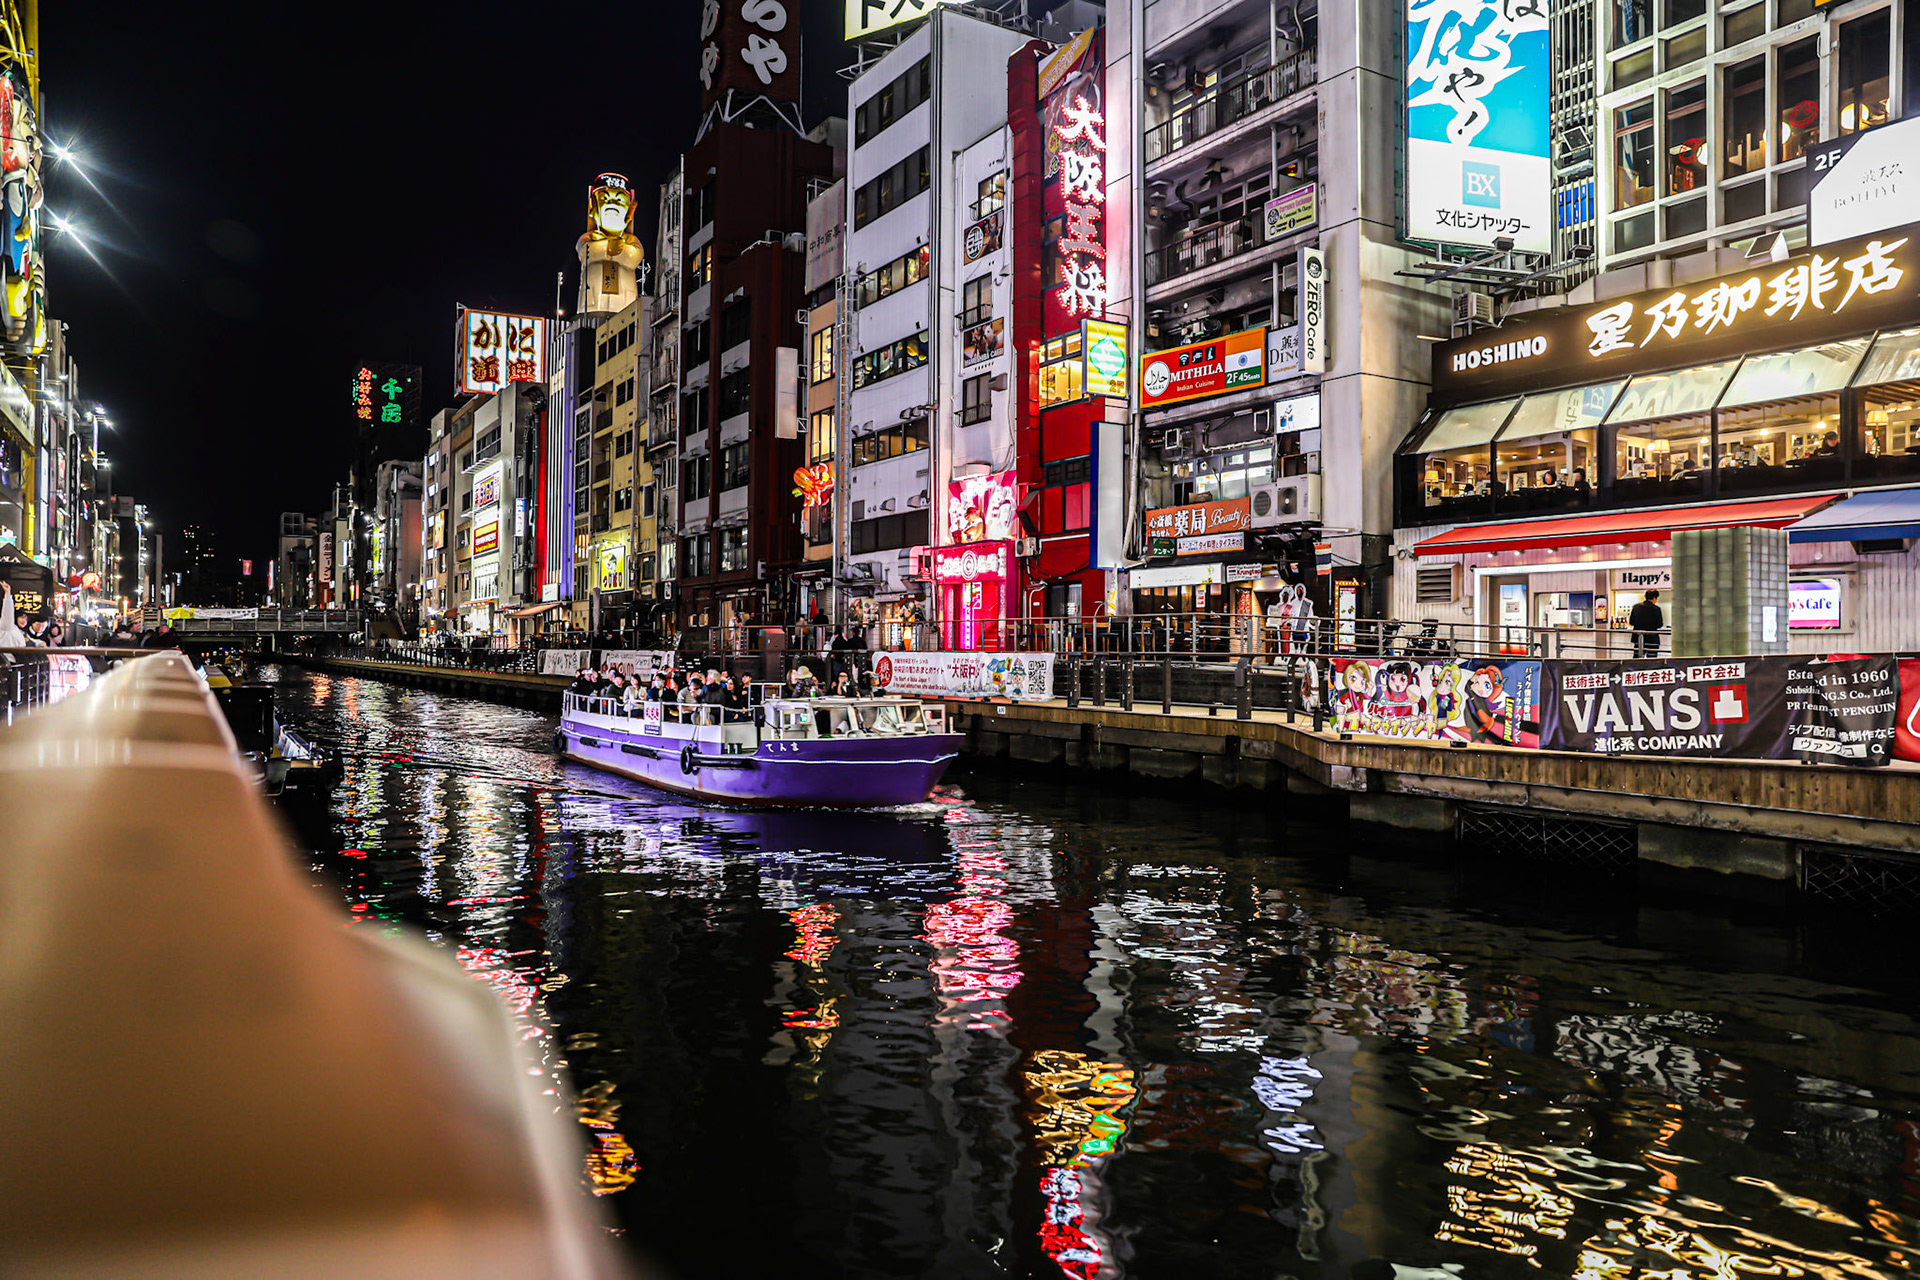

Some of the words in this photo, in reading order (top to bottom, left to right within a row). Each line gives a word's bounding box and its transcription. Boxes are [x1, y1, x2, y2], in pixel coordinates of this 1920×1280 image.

[1814, 148, 1842, 171] 2F
[1467, 172, 1496, 198] BX
[1054, 93, 1106, 316] 大阪王将
[1307, 280, 1319, 327] ZERO
[1586, 237, 1909, 357] 星乃珈琲店
[471, 319, 536, 355] かに
[1452, 335, 1548, 372] HOSHINO
[1170, 362, 1224, 383] MITHILA
[1226, 372, 1239, 384] 2F
[356, 367, 373, 420] お好み焼
[1109, 379, 1125, 393] 2F
[1177, 384, 1193, 392] Indian
[1195, 379, 1215, 389] Cuisine
[381, 378, 403, 424] 千房
[1174, 507, 1207, 537] 薬局
[1207, 506, 1243, 529] Beauty
[1622, 571, 1670, 585] Happy's
[1806, 597, 1832, 610] Cafe
[1565, 675, 1607, 688] 技術会社
[1625, 670, 1673, 685] 制作会社
[1832, 674, 1847, 685] in
[1851, 669, 1889, 684] 1960
[1872, 686, 1894, 697] Ltd.
[1563, 687, 1701, 733] VANS
[1786, 702, 1800, 711] PR
[1802, 702, 1828, 712] Team
[1843, 702, 1896, 717] PENGUIN
[765, 741, 799, 753] てんま
[1594, 735, 1635, 752] 進化系
[1638, 733, 1724, 751] COMPANY
